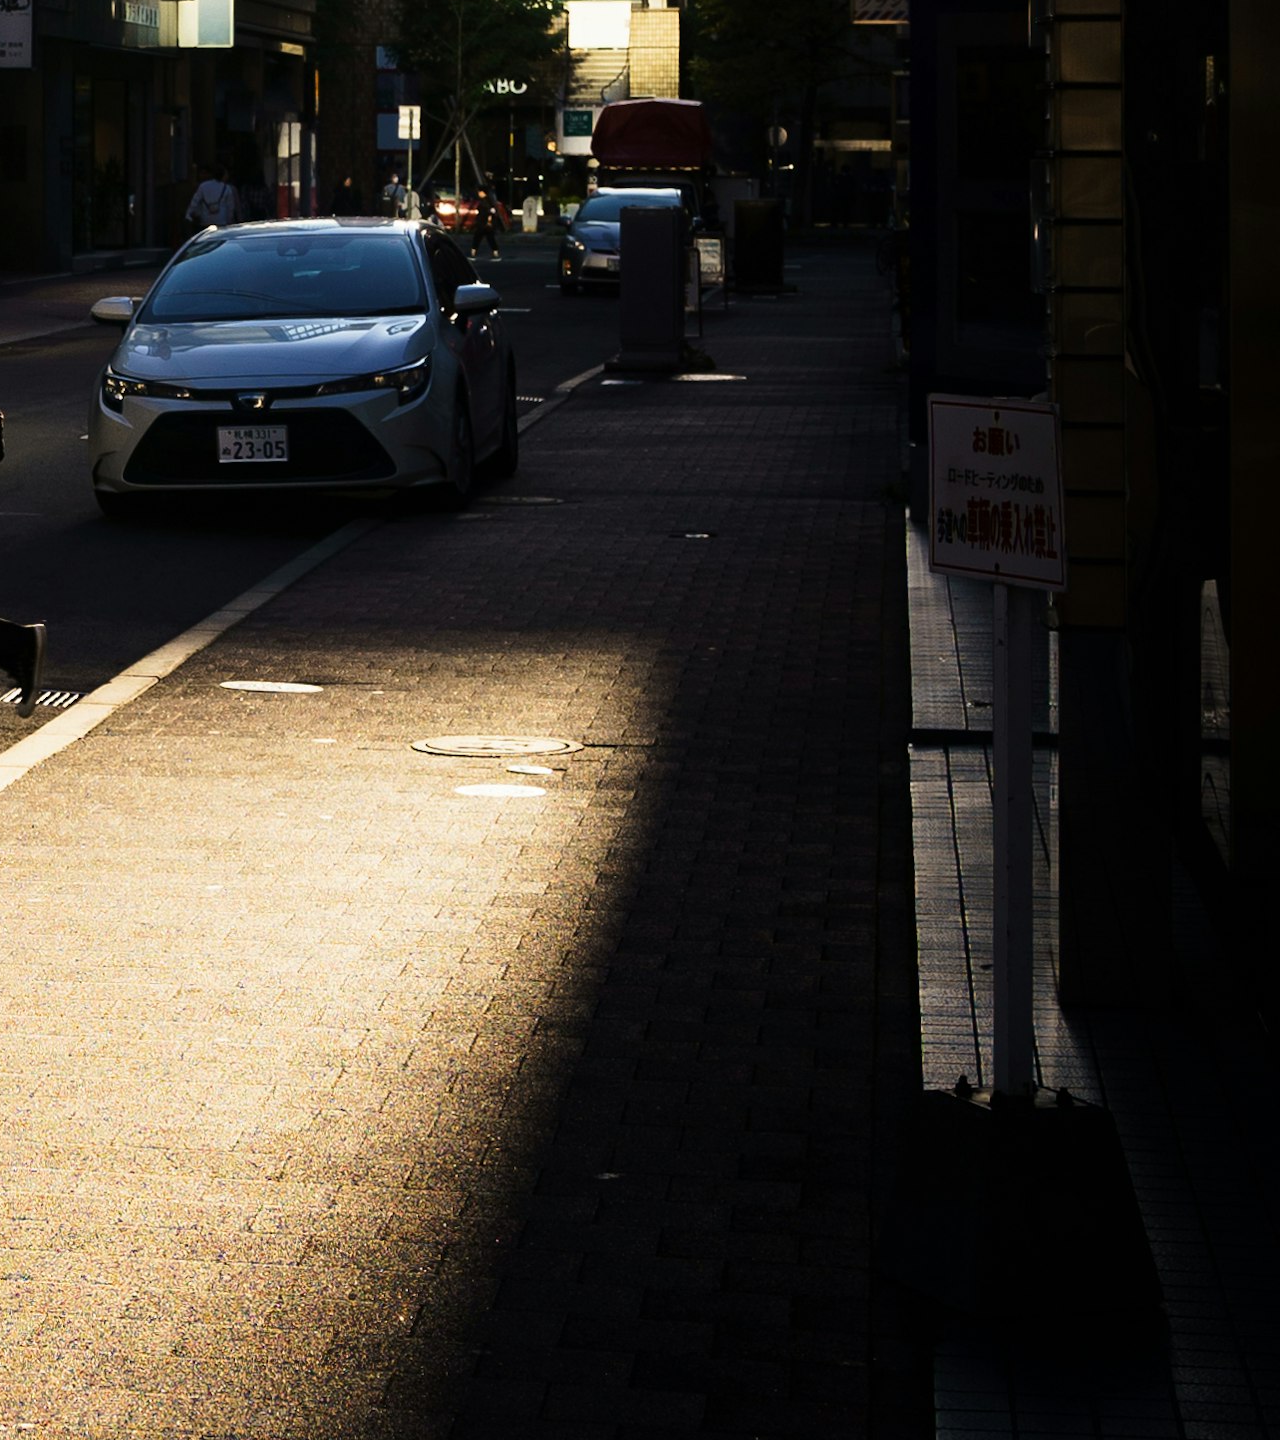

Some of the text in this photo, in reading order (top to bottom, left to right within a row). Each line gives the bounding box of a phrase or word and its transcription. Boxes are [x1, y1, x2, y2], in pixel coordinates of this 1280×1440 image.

[255, 428, 271, 440] 331
[973, 427, 1020, 456] お願い
[233, 441, 286, 460] 23-05
[948, 468, 1044, 494] ロードヒーティングのため
